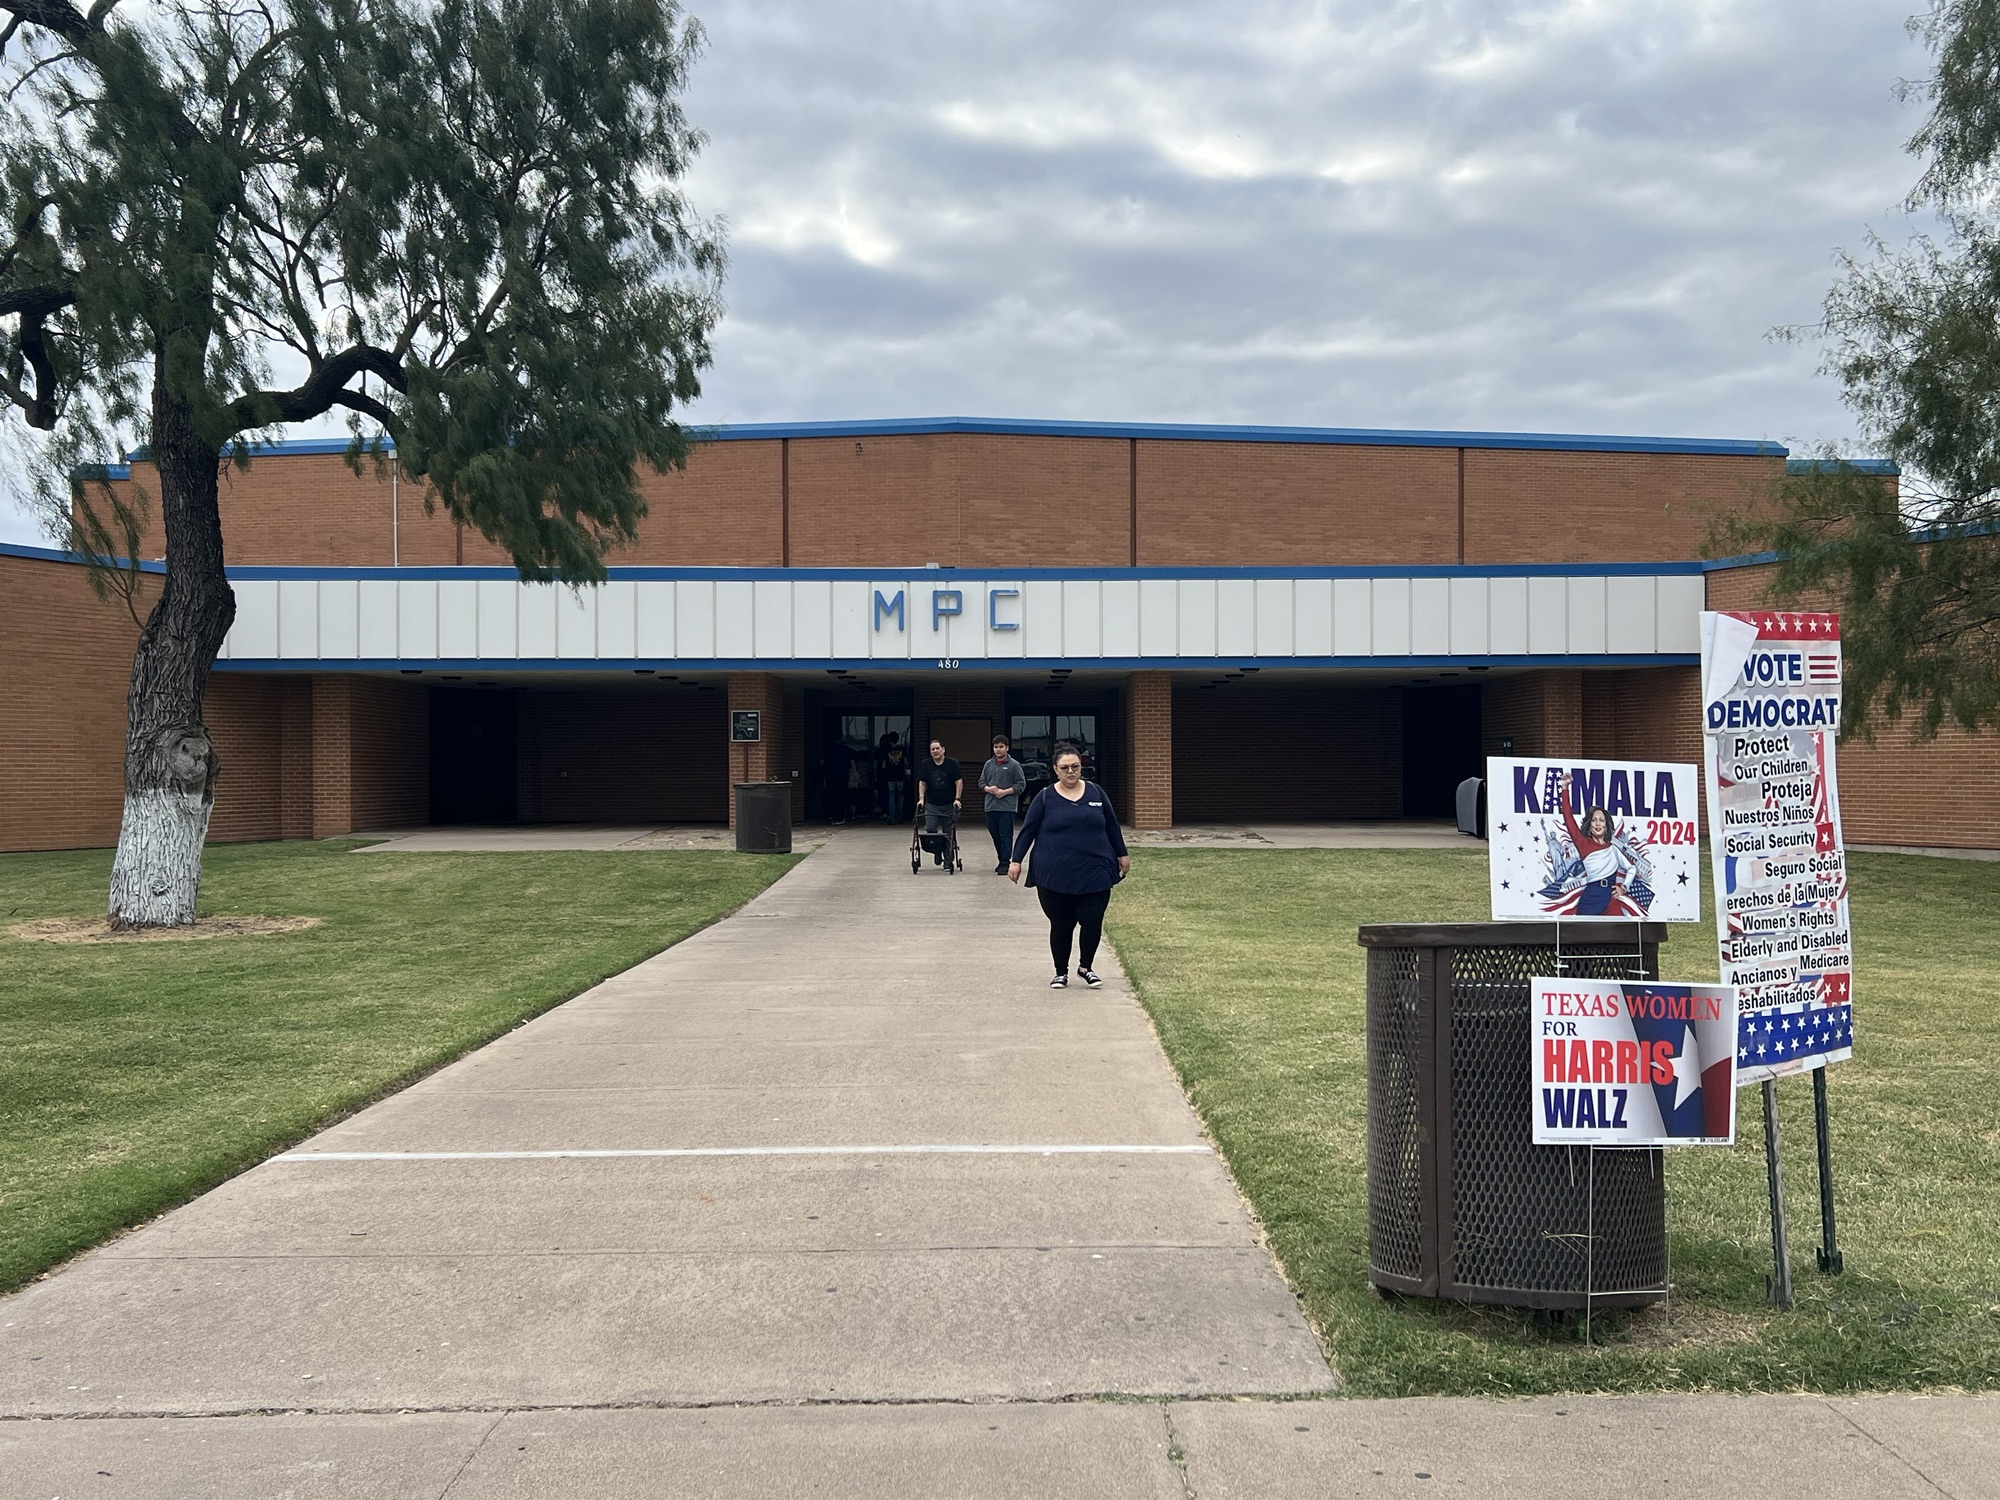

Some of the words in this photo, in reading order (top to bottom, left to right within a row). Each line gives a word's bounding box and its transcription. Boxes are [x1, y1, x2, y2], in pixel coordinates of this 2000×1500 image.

[938, 659, 960, 669] 480
[1743, 653, 1803, 682] VOTE
[1707, 698, 1839, 729] DEMOCRAT
[1734, 735, 1790, 757] Protect
[1734, 764, 1758, 781] Our
[1761, 758, 1808, 778] Children
[1513, 766, 1679, 818] KAMALA
[1761, 779, 1812, 801] Proteja
[1725, 807, 1779, 825] Nuestros
[1783, 802, 1815, 821] Niños
[1646, 820, 1696, 846] 2024
[1727, 835, 1765, 854] Social
[1769, 831, 1816, 848] Security
[1765, 862, 1806, 879] Seguro
[1809, 855, 1842, 873] Social
[1777, 888, 1791, 904] de
[1795, 886, 1805, 902] la
[1807, 883, 1839, 902] Mujer
[1742, 912, 1796, 931] Women's
[1799, 910, 1835, 930] Rights
[1731, 939, 1774, 959] Elderly
[1777, 936, 1798, 953] and
[1802, 930, 1848, 950] Disabled
[1800, 953, 1849, 971] Medicare
[1731, 968, 1788, 986] Ancianos
[1790, 966, 1797, 981] y
[1541, 993, 1620, 1018] TEXAS
[1626, 995, 1722, 1020] WOMEN
[1542, 1021, 1578, 1036] FOR
[1543, 1039, 1674, 1086] HARRIS
[1542, 1088, 1628, 1129] WALZ
